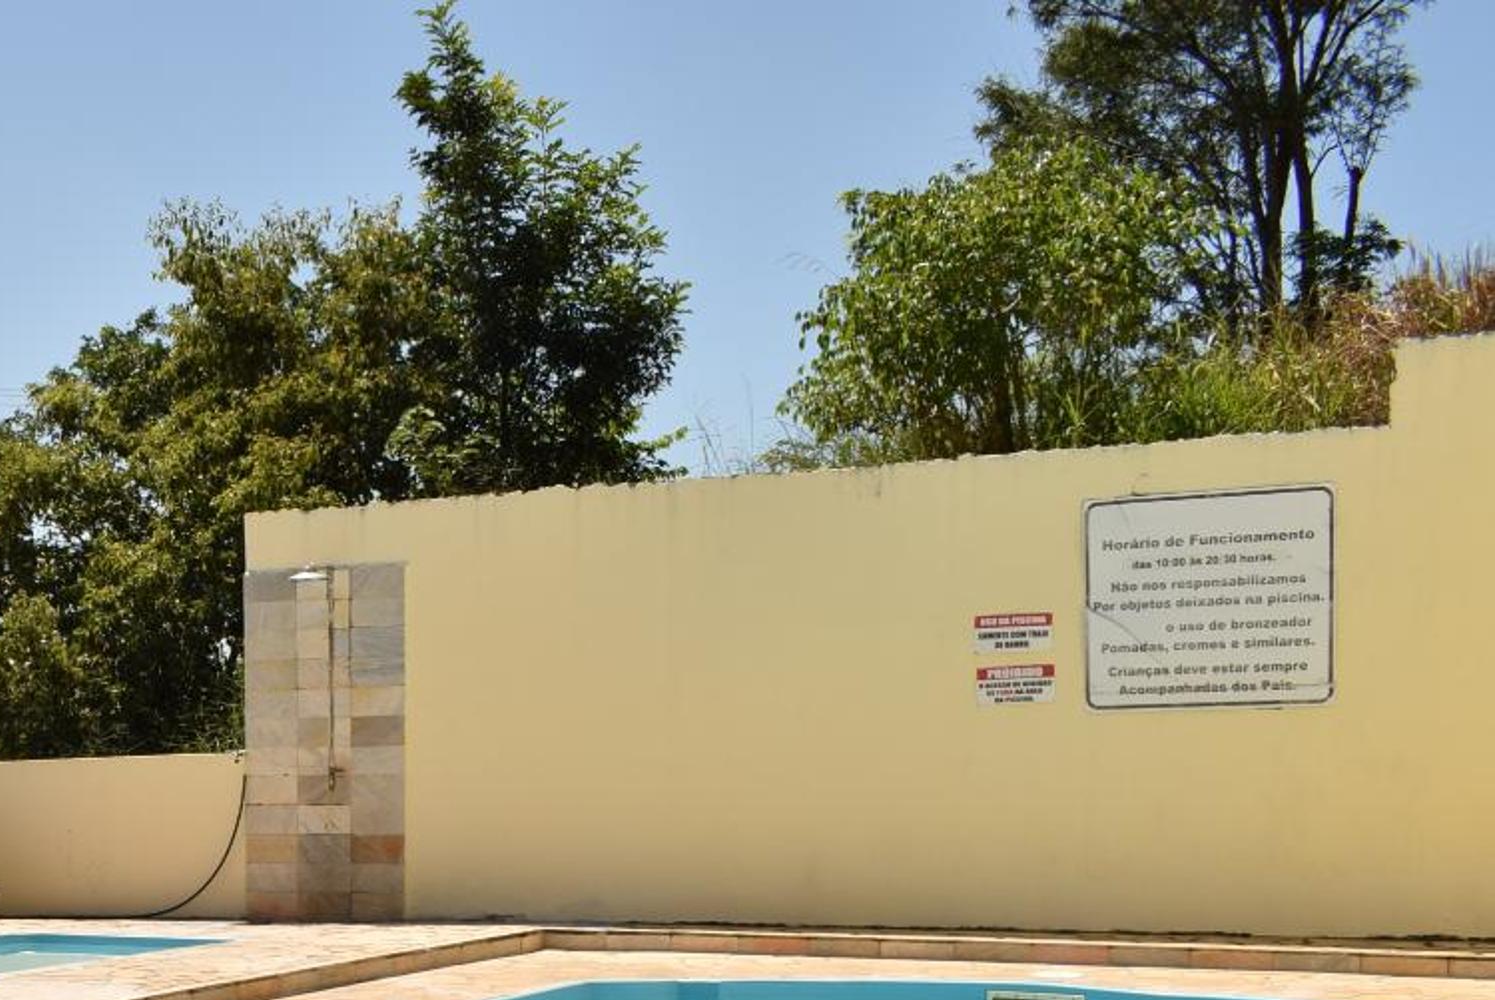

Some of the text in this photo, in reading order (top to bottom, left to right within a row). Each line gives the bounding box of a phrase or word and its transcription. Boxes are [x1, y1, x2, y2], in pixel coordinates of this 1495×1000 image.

[1102, 529, 1315, 551] Horário de Funcionamento
[1132, 560, 1152, 570] das
[1111, 573, 1306, 593] Não nos responsabilizamos
[1093, 591, 1324, 613] Por objetos deixados na piscina.
[1165, 616, 1312, 633] o uso de bronzeador
[1231, 640, 1240, 649] e
[1108, 660, 1308, 679] Crianças deve estar sempre
[1119, 682, 1228, 697] Acompanhadas
[1232, 681, 1256, 692] dos
